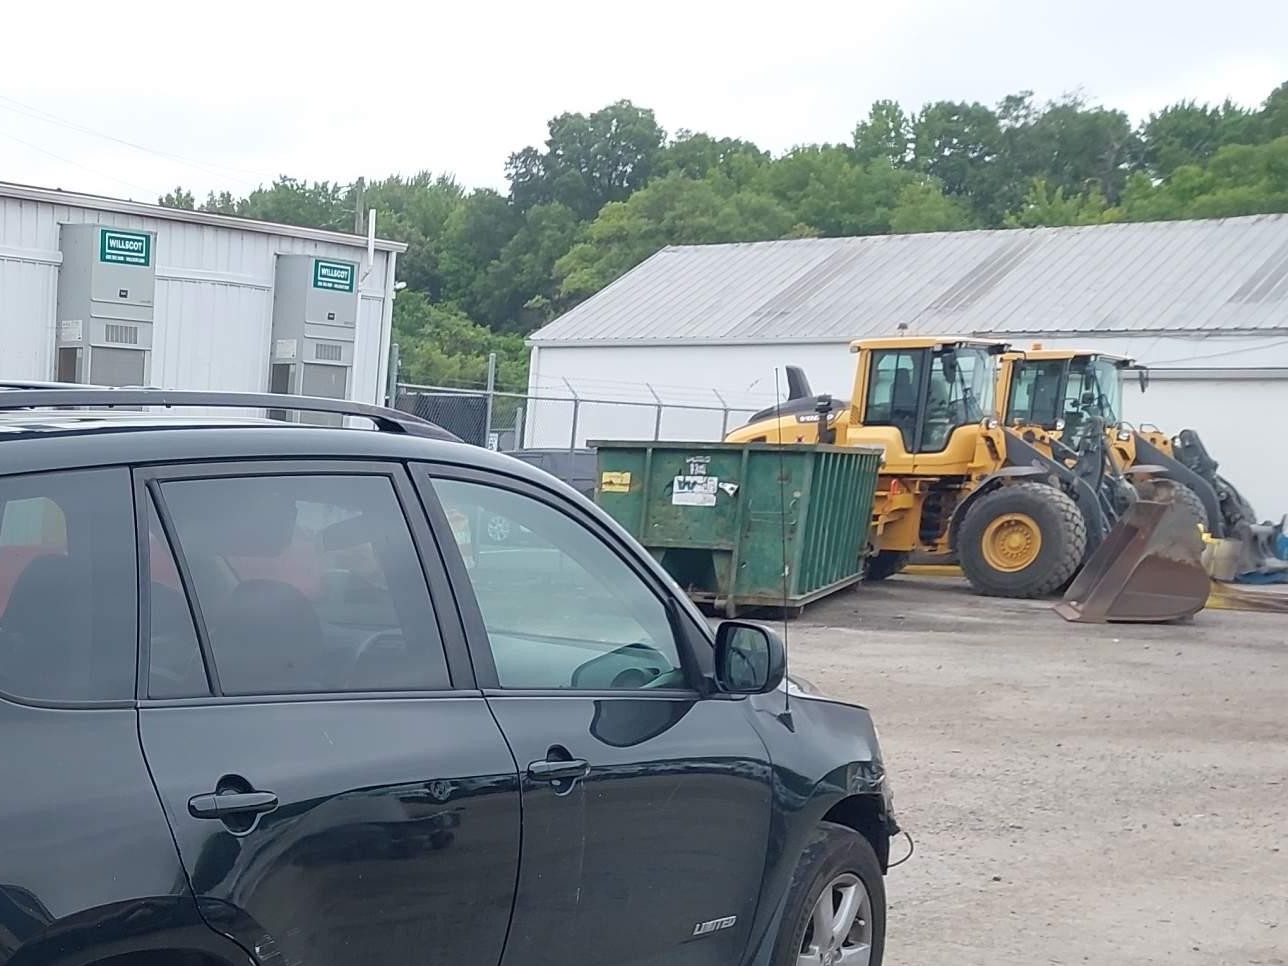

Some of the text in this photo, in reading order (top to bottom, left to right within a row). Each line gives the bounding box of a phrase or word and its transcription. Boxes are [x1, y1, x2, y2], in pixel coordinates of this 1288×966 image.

[109, 238, 143, 251] WILLSCOT
[321, 267, 348, 279] WILLSCOT
[693, 915, 737, 936] LIMITED
